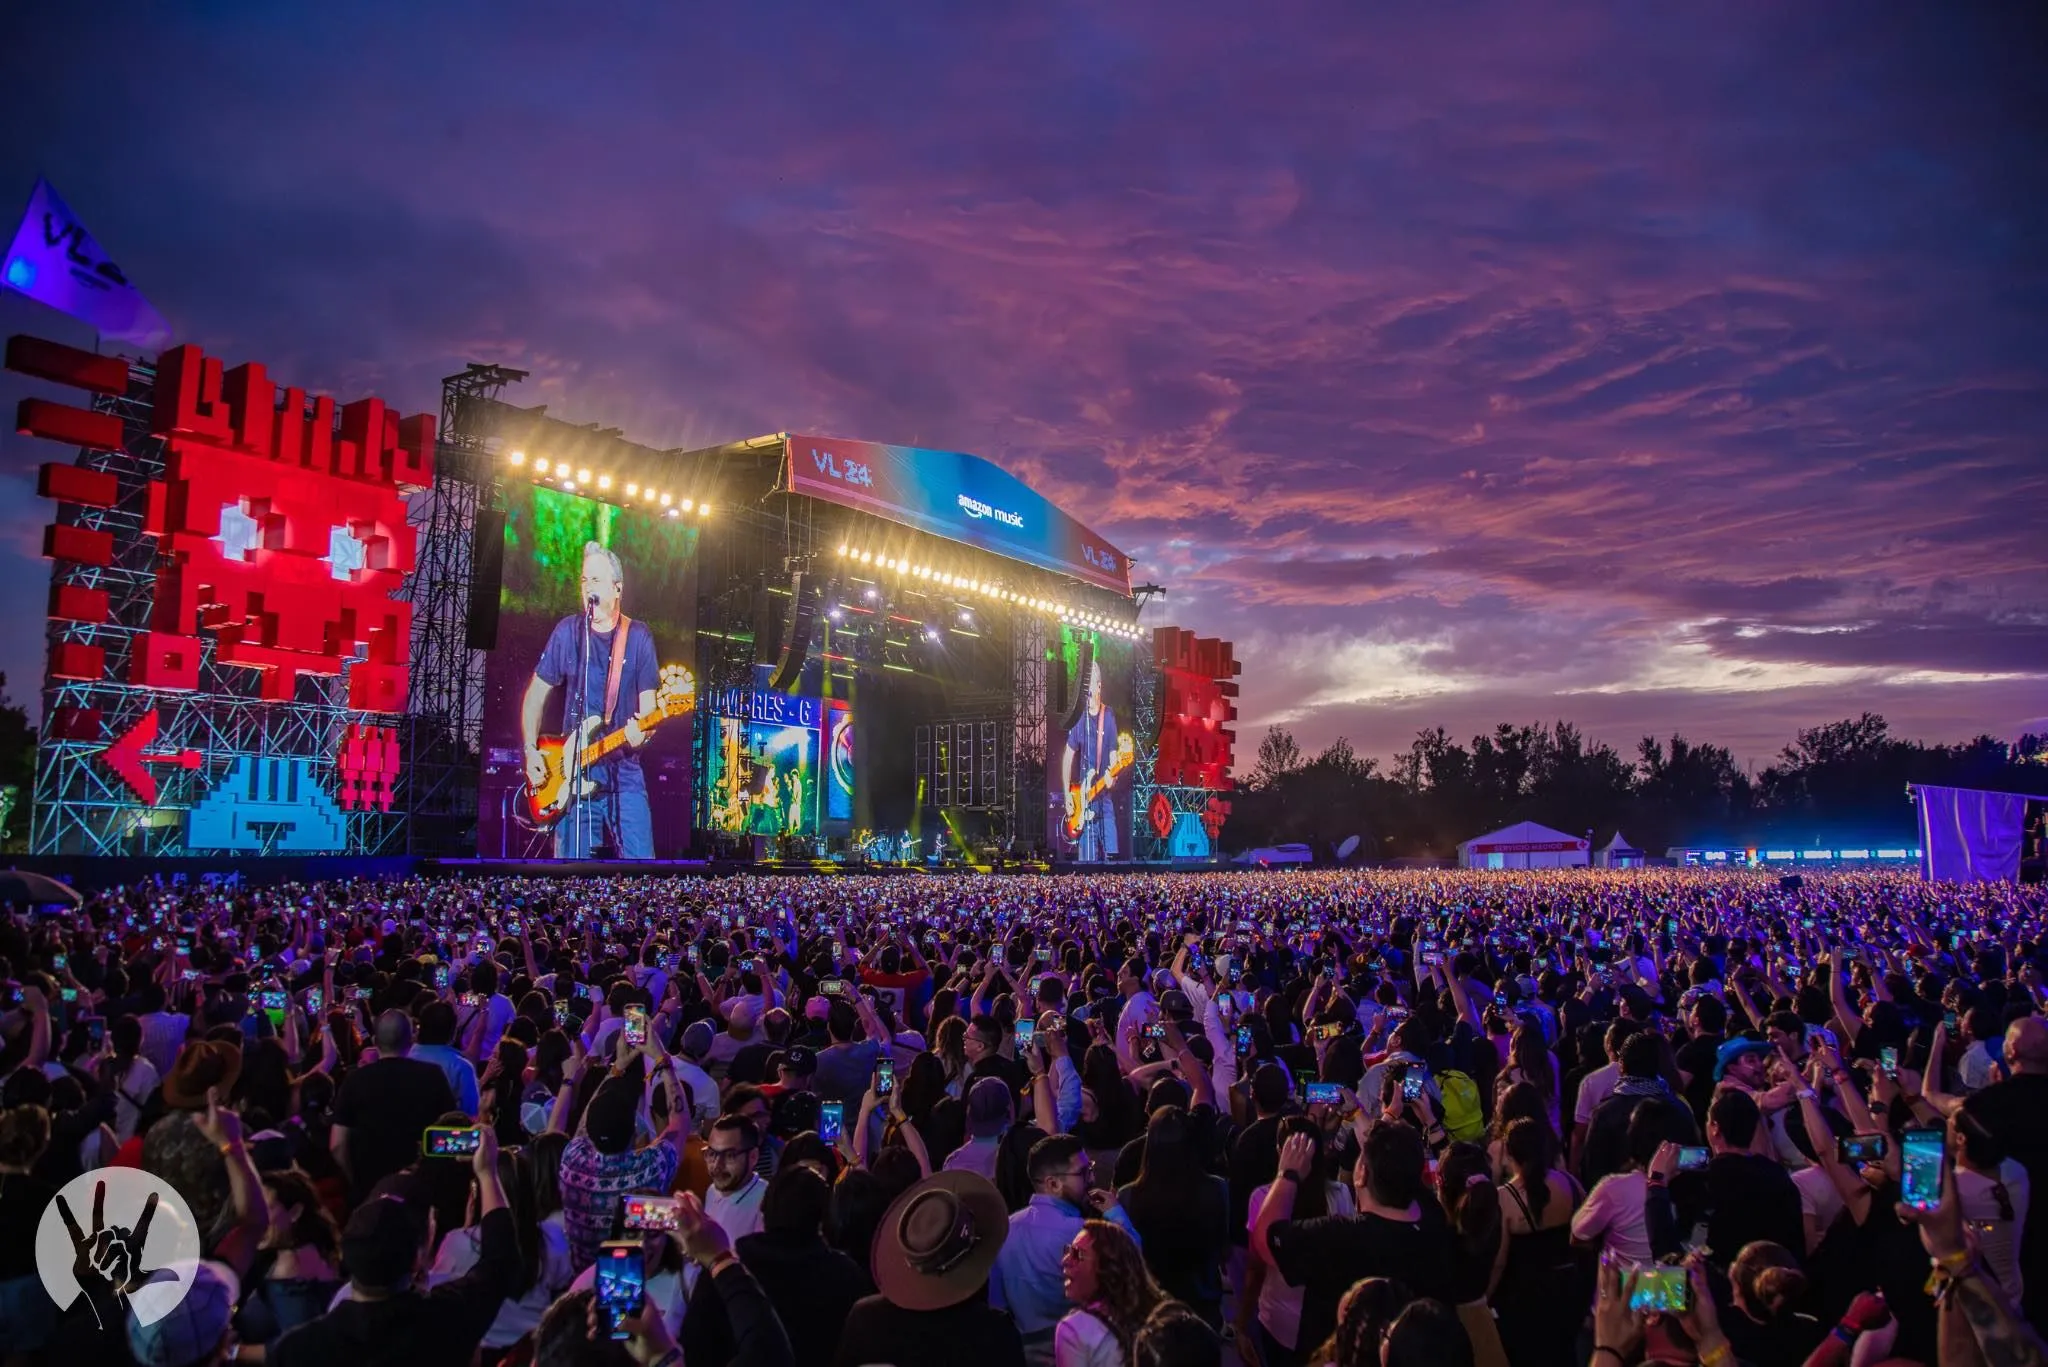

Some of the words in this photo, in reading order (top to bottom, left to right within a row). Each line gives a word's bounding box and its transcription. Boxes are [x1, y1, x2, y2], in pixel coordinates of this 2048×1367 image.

[44, 212, 93, 266] VL
[812, 448, 842, 478] VL
[844, 459, 874, 487] 24
[958, 494, 992, 518] amazon
[994, 509, 1024, 528] music
[1081, 543, 1099, 566] VL
[800, 699, 811, 725] G
